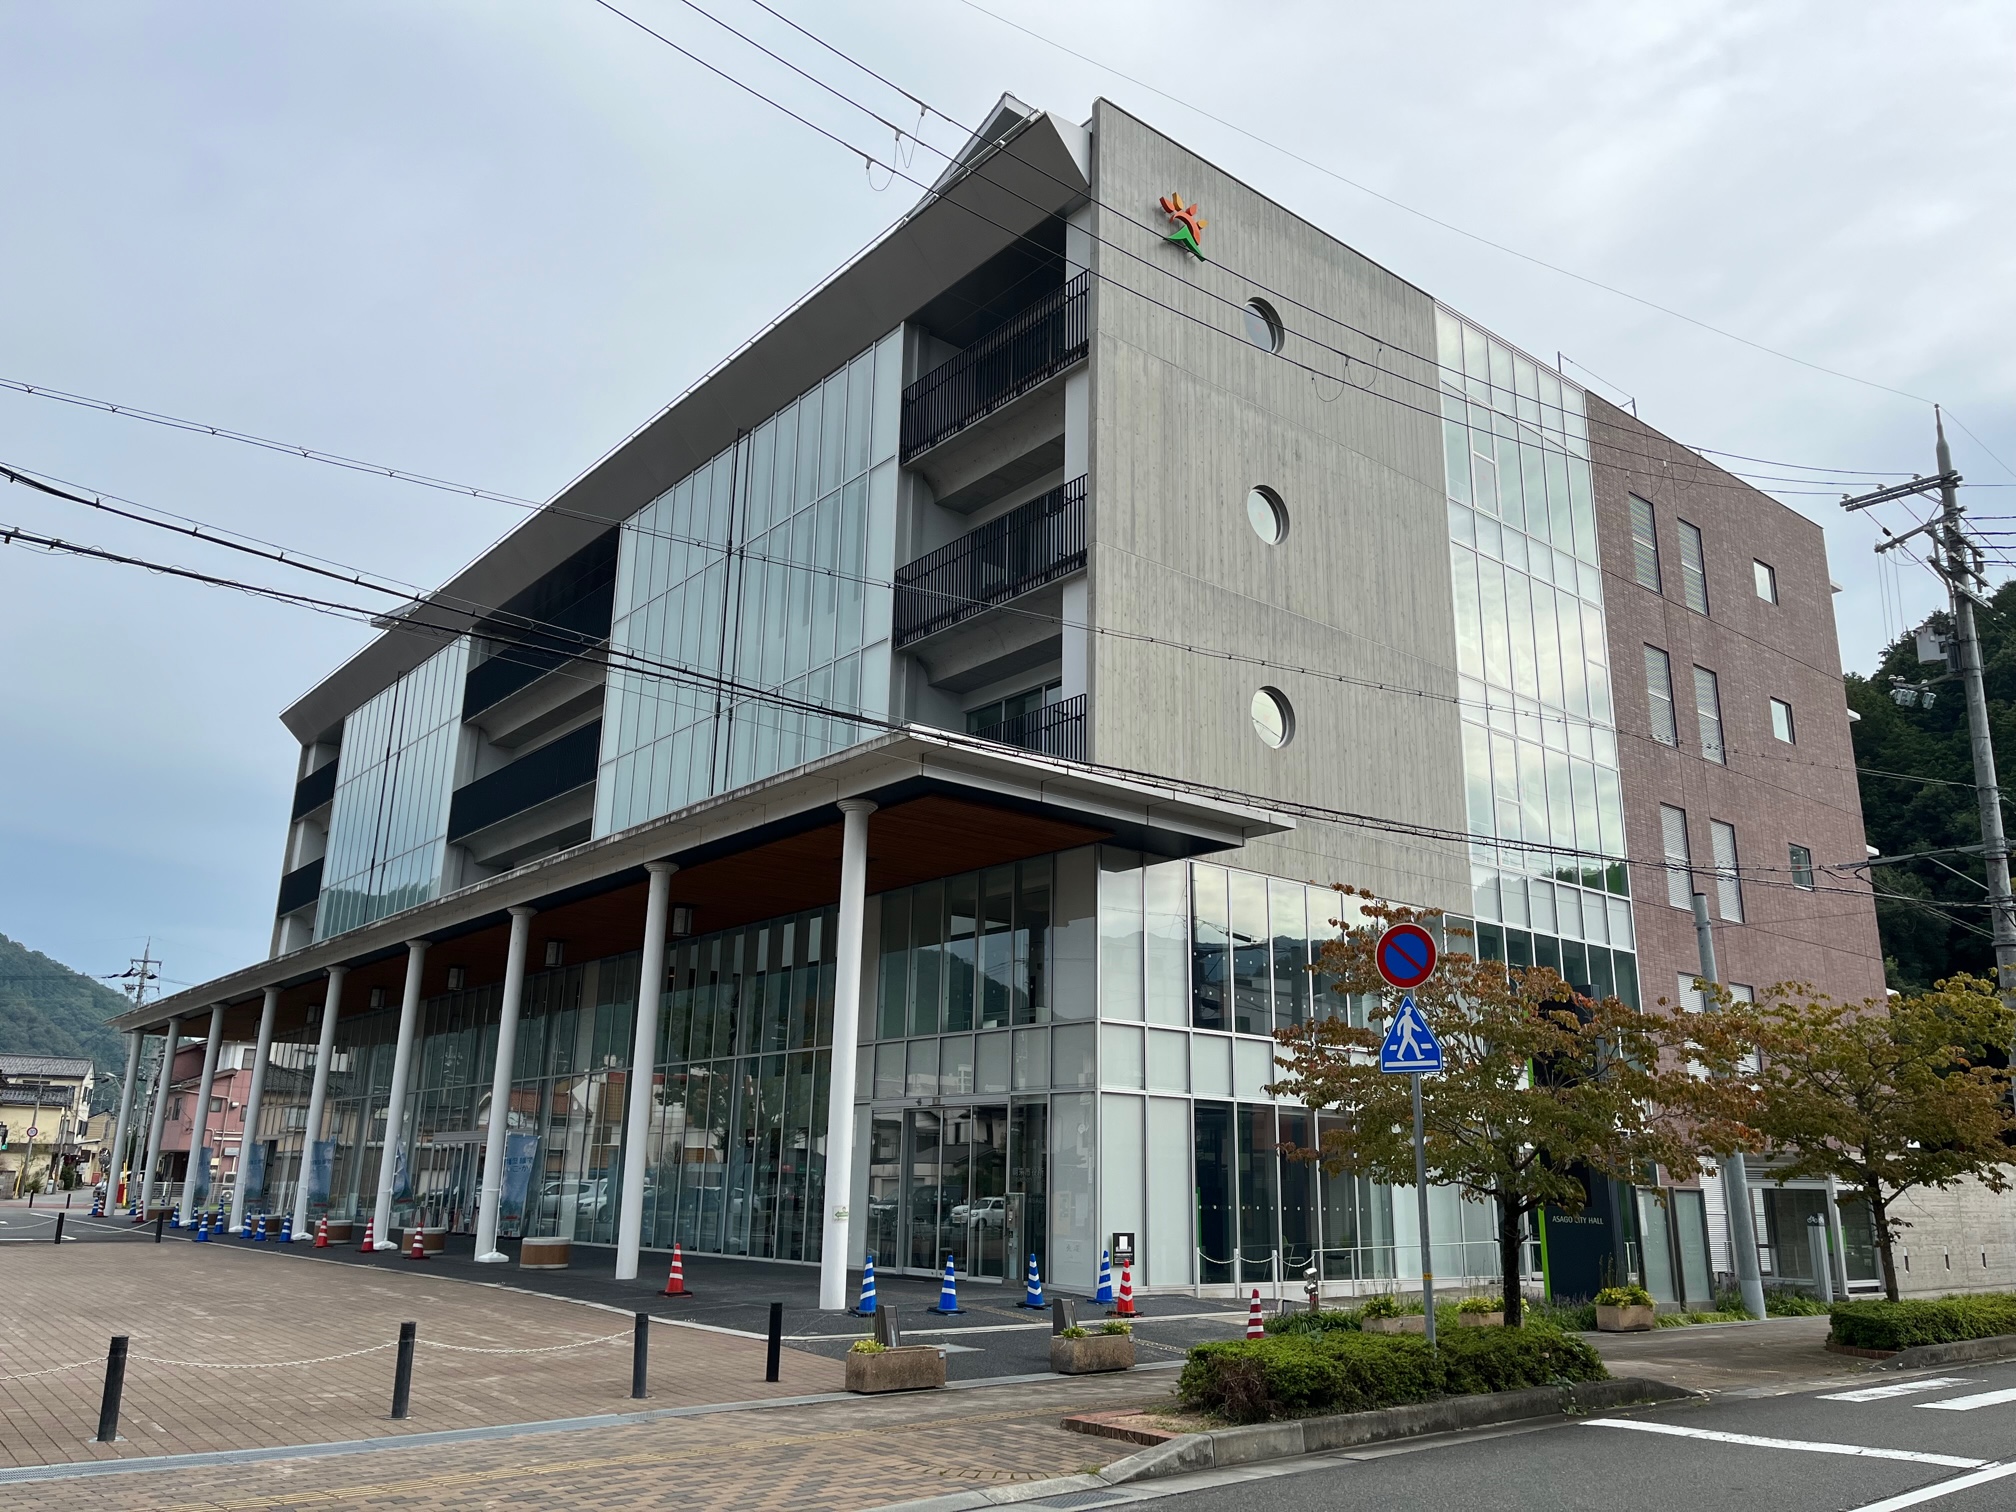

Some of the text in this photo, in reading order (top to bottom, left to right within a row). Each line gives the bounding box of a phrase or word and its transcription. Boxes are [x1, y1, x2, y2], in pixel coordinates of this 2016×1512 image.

[1552, 1215, 1604, 1225] ASAGO CITY HALL
